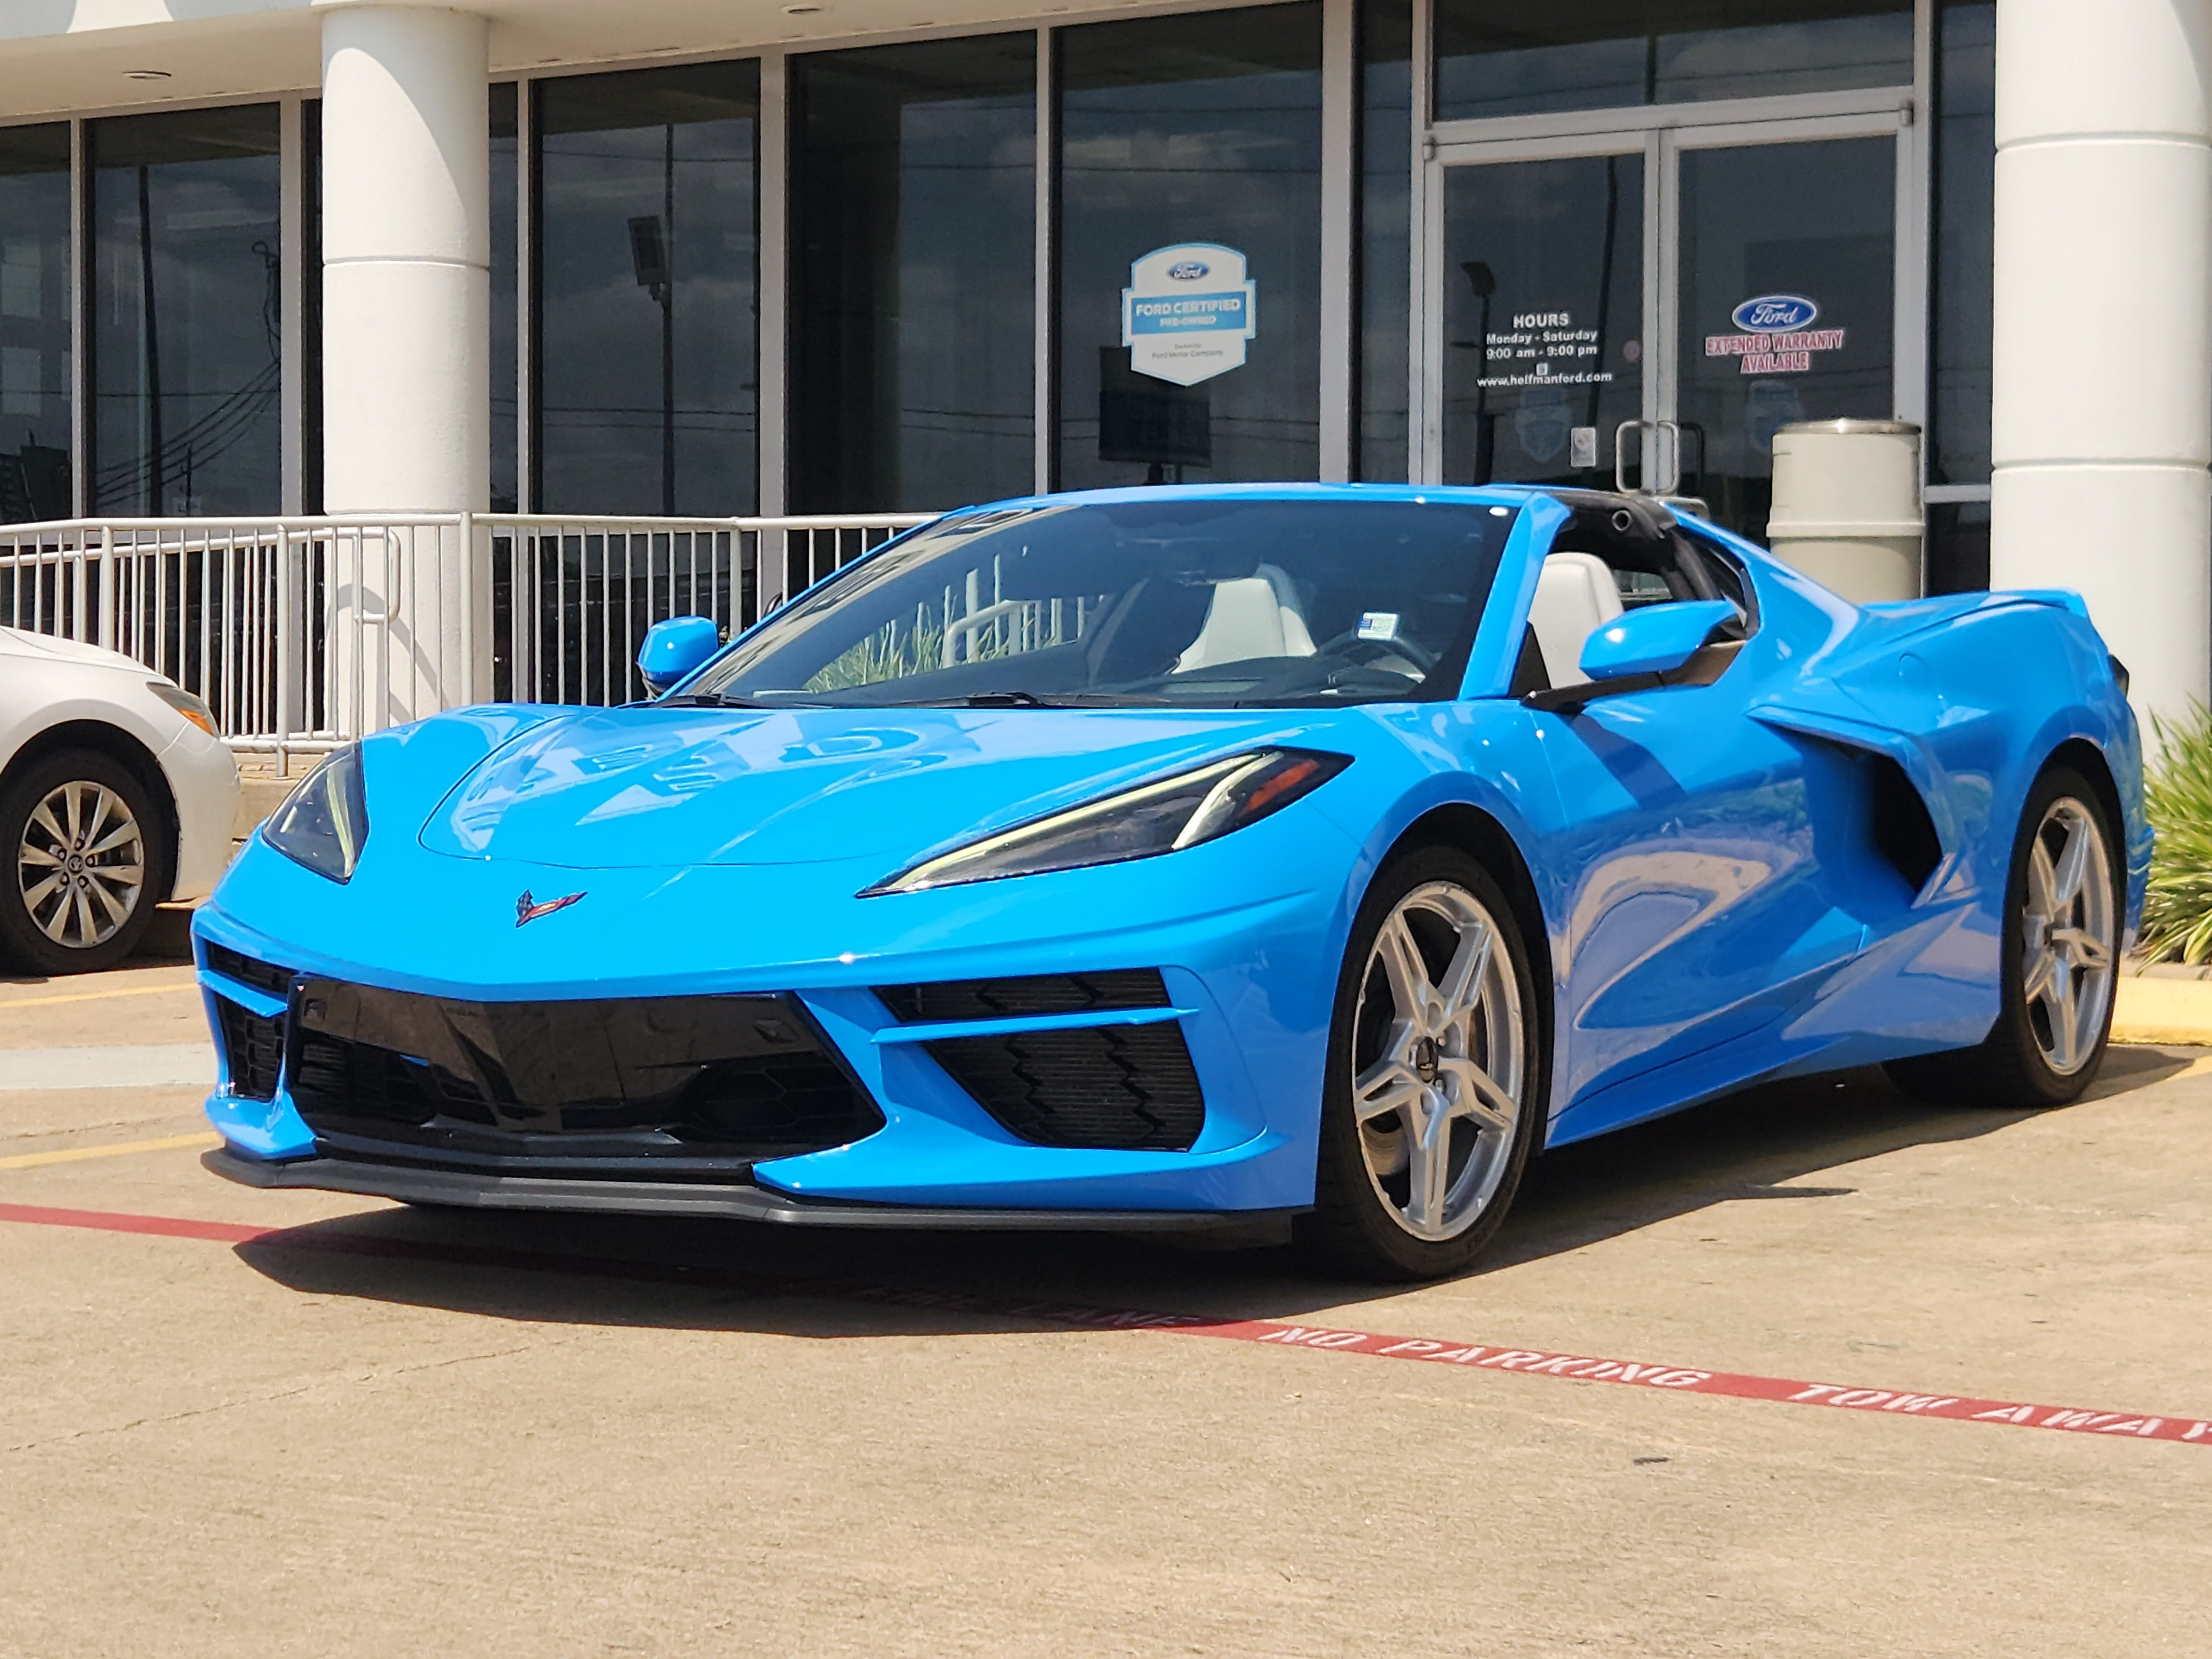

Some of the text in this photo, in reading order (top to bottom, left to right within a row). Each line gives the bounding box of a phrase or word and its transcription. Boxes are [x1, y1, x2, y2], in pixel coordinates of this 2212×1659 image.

[1174, 262, 1202, 278] Ford
[1136, 299, 1241, 316] FORD CERTIFIED
[1750, 303, 1798, 325] Ford
[1513, 313, 1569, 328] HOURS
[1486, 333, 1531, 345] Monday
[1543, 330, 1598, 342] Saturday
[1706, 330, 1843, 356] EXTENDED WARRANTY
[1486, 348, 1511, 360] 9:00
[1516, 349, 1535, 358] am
[1547, 345, 1573, 357] 9:00
[1578, 346, 1598, 358] pm
[1740, 352, 1809, 374] AVAILABLE
[1258, 1327, 1367, 1344] NO
[1376, 1339, 1712, 1387] PARKING
[1788, 1384, 1959, 1412] TOW
